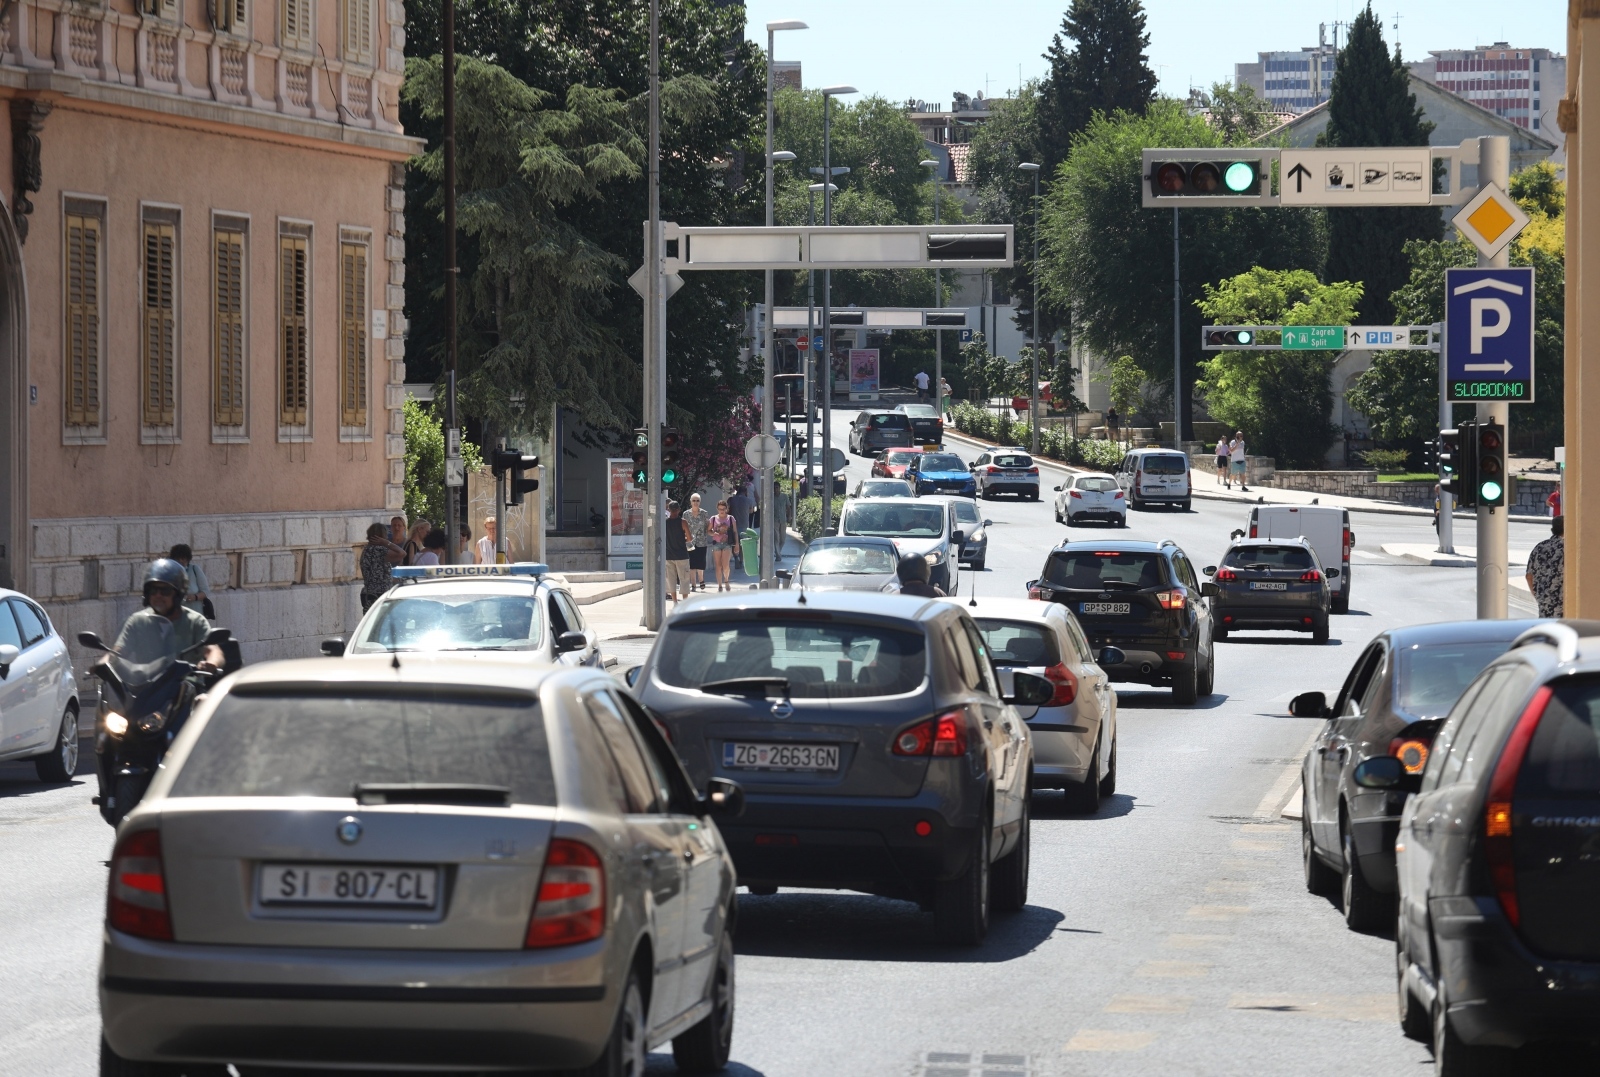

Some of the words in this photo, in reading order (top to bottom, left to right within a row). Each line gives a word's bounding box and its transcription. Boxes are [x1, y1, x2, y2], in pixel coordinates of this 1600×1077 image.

[1470, 297, 1511, 354] P
[962, 330, 969, 340] P
[1311, 327, 1336, 337] Zagreb
[1311, 338, 1328, 347] Split
[1368, 333, 1376, 342] P
[1382, 333, 1390, 342] H
[1454, 382, 1524, 397] SLOBODNO
[624, 501, 643, 509] nute
[435, 566, 500, 576] POLICIJA
[1084, 603, 1096, 612] GP
[1100, 603, 1112, 612] SP
[1113, 603, 1129, 612] 882
[736, 745, 757, 765] ZG
[334, 869, 428, 900] 807-CL
